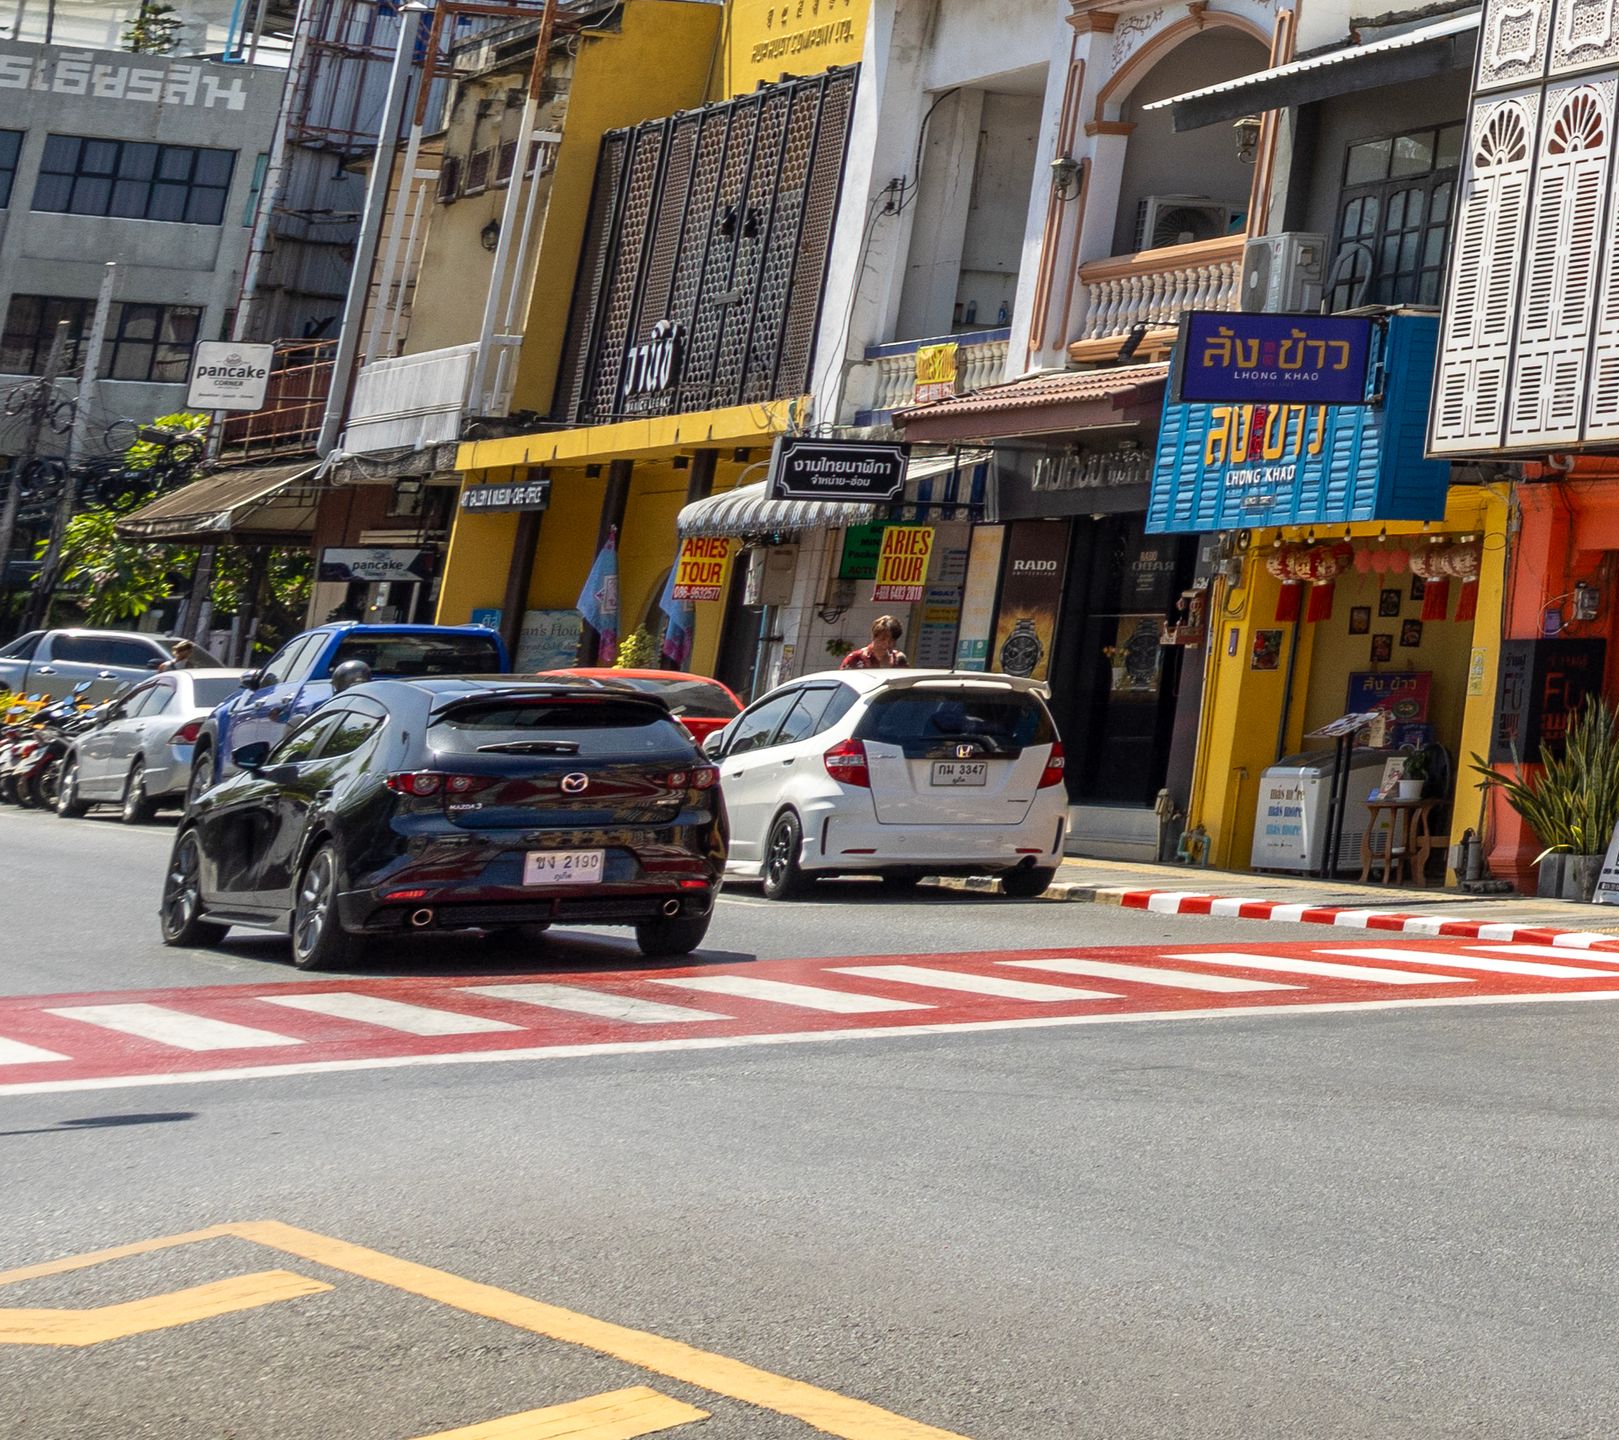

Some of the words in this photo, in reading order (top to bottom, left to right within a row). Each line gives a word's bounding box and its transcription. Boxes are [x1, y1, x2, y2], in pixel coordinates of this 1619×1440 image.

[197, 365, 266, 379] pancake
[1234, 371, 1278, 381] LHONG
[1284, 372, 1319, 381] KHAO
[794, 456, 892, 475] งามไทยนาฬิกา
[1225, 468, 1261, 486] LHONG
[1265, 464, 1296, 482] KHAO
[682, 537, 730, 558] ARIES
[882, 529, 931, 556] ARIES
[352, 561, 404, 571] pancake
[681, 561, 722, 583] TOUR
[882, 556, 924, 582] TOUR
[1014, 560, 1057, 570] RADO
[959, 764, 985, 776] 3347
[564, 854, 598, 869] 2190
